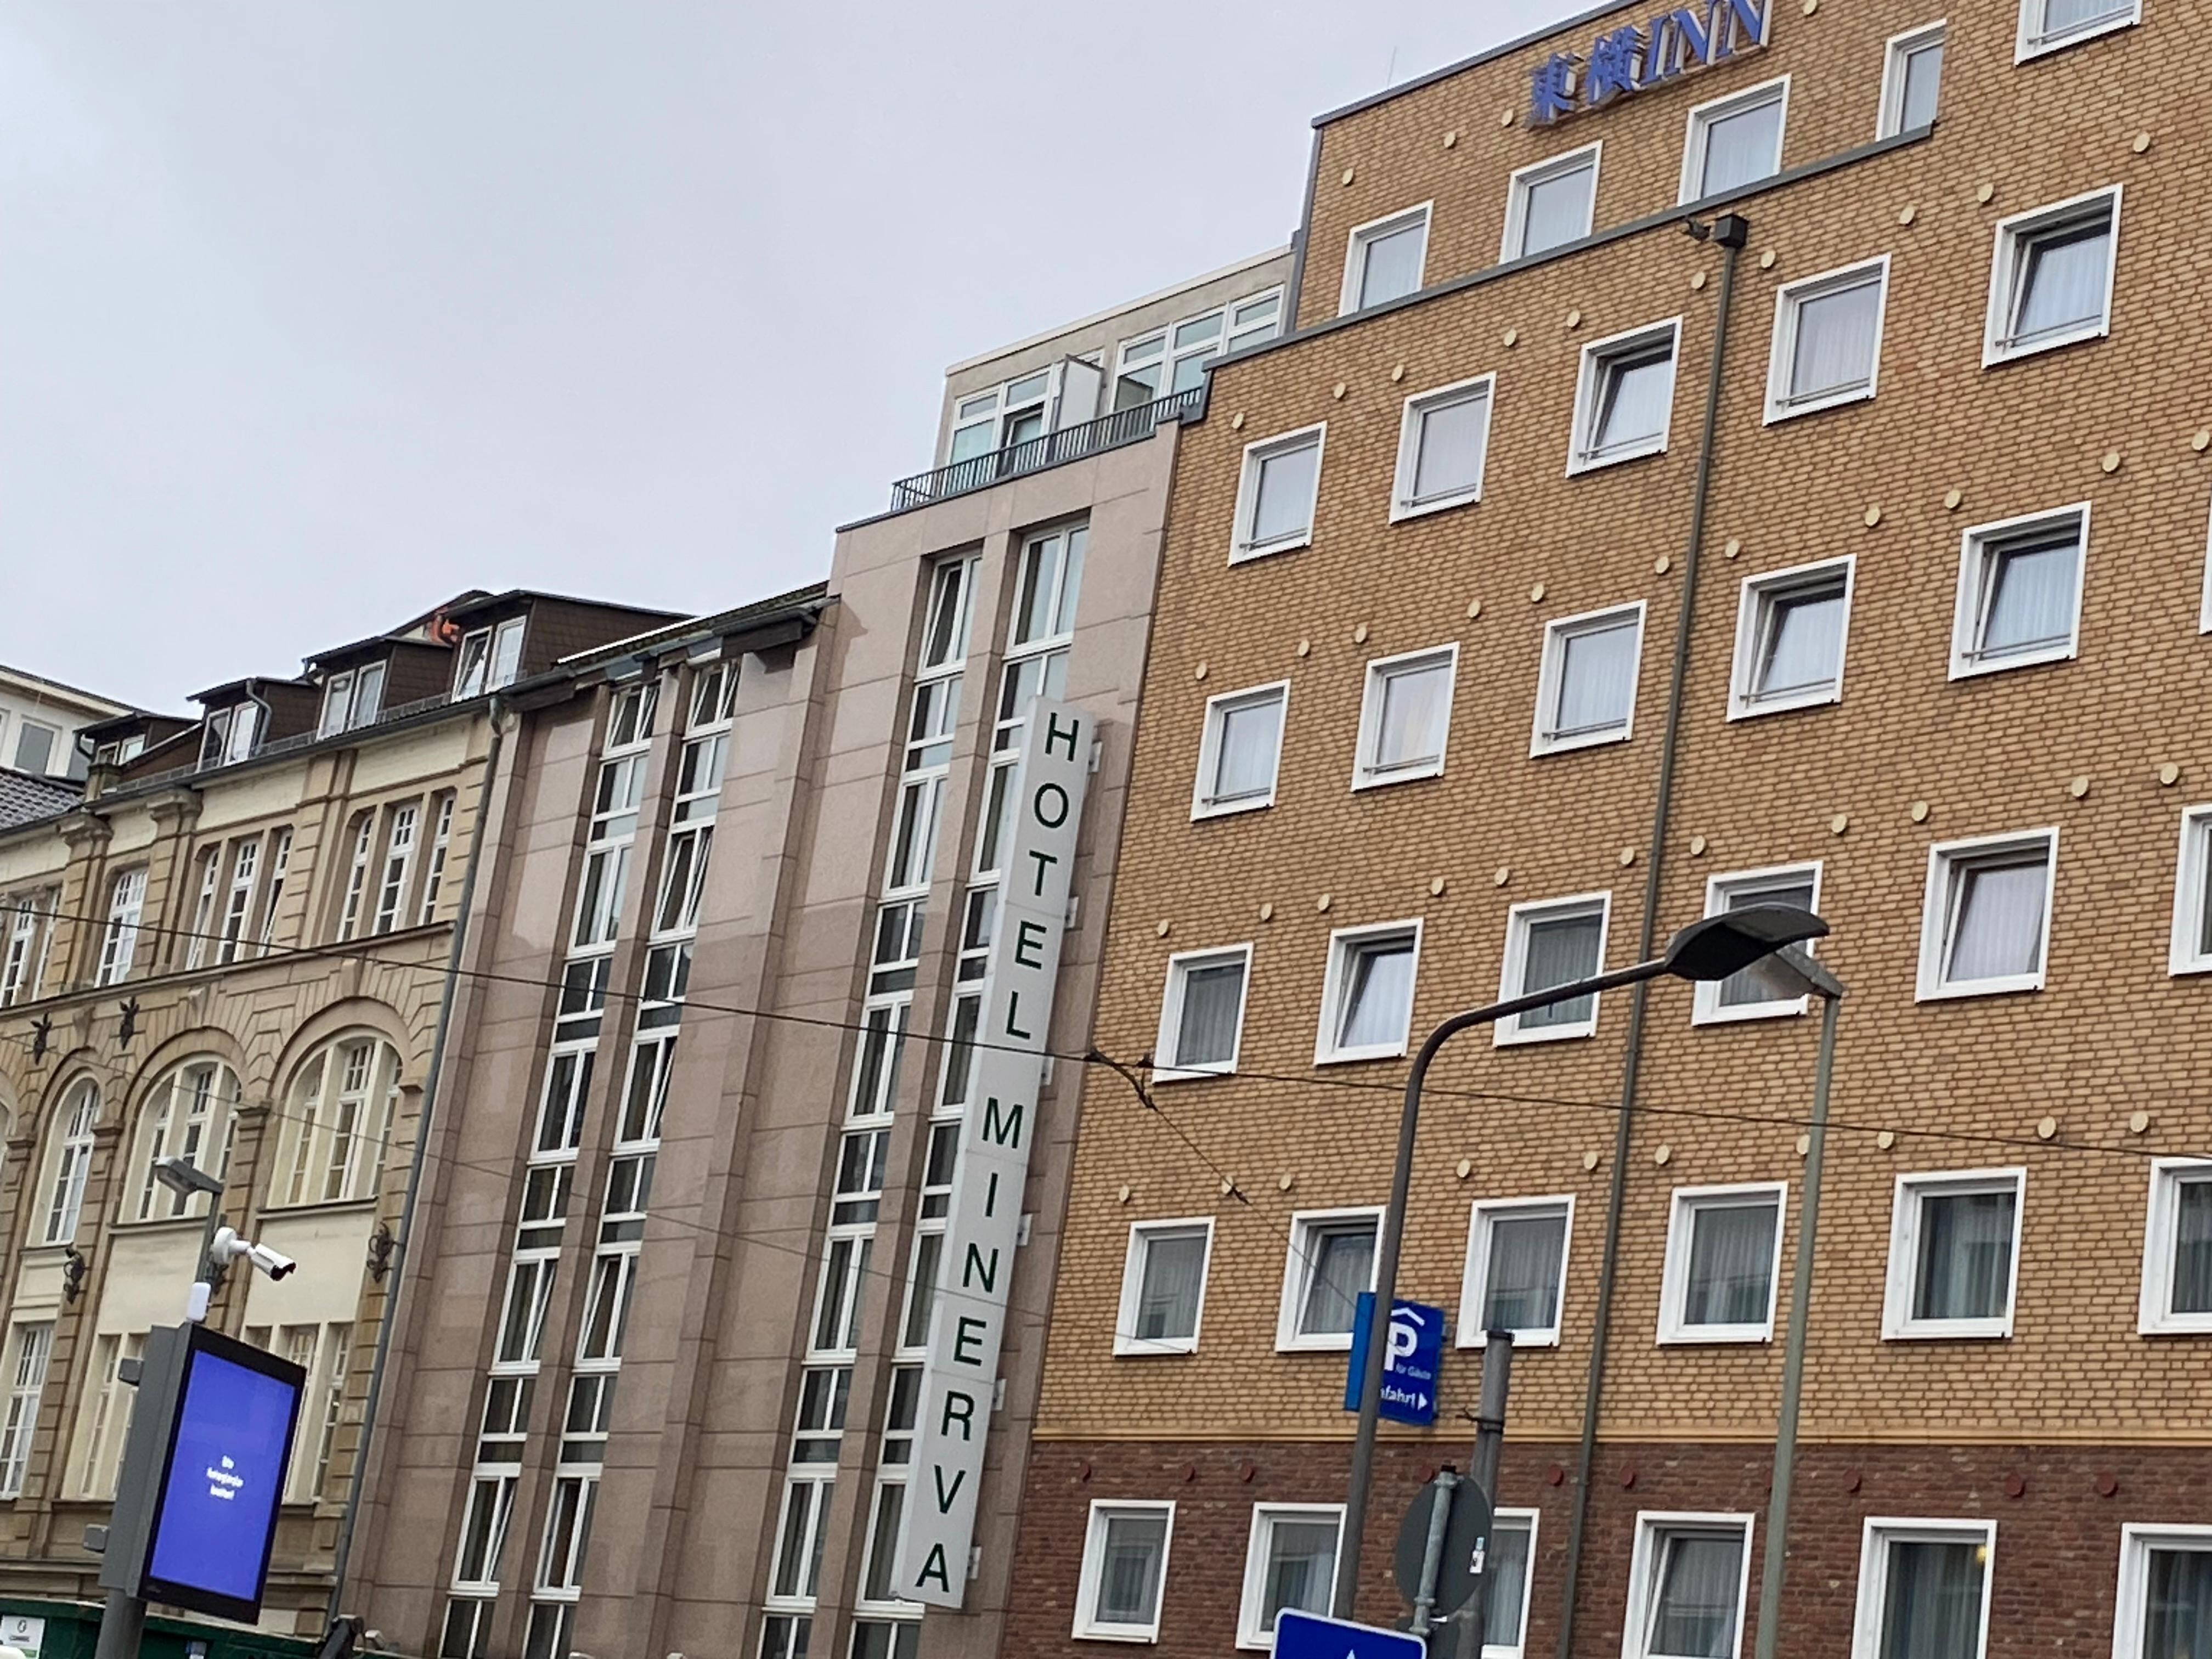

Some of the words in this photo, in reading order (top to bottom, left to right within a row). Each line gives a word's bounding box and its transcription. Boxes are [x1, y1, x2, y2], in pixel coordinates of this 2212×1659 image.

[1006, 712, 1079, 1040] HOTEL
[916, 1097, 1024, 1593] MINERVA
[1384, 1321, 1418, 1371] P
